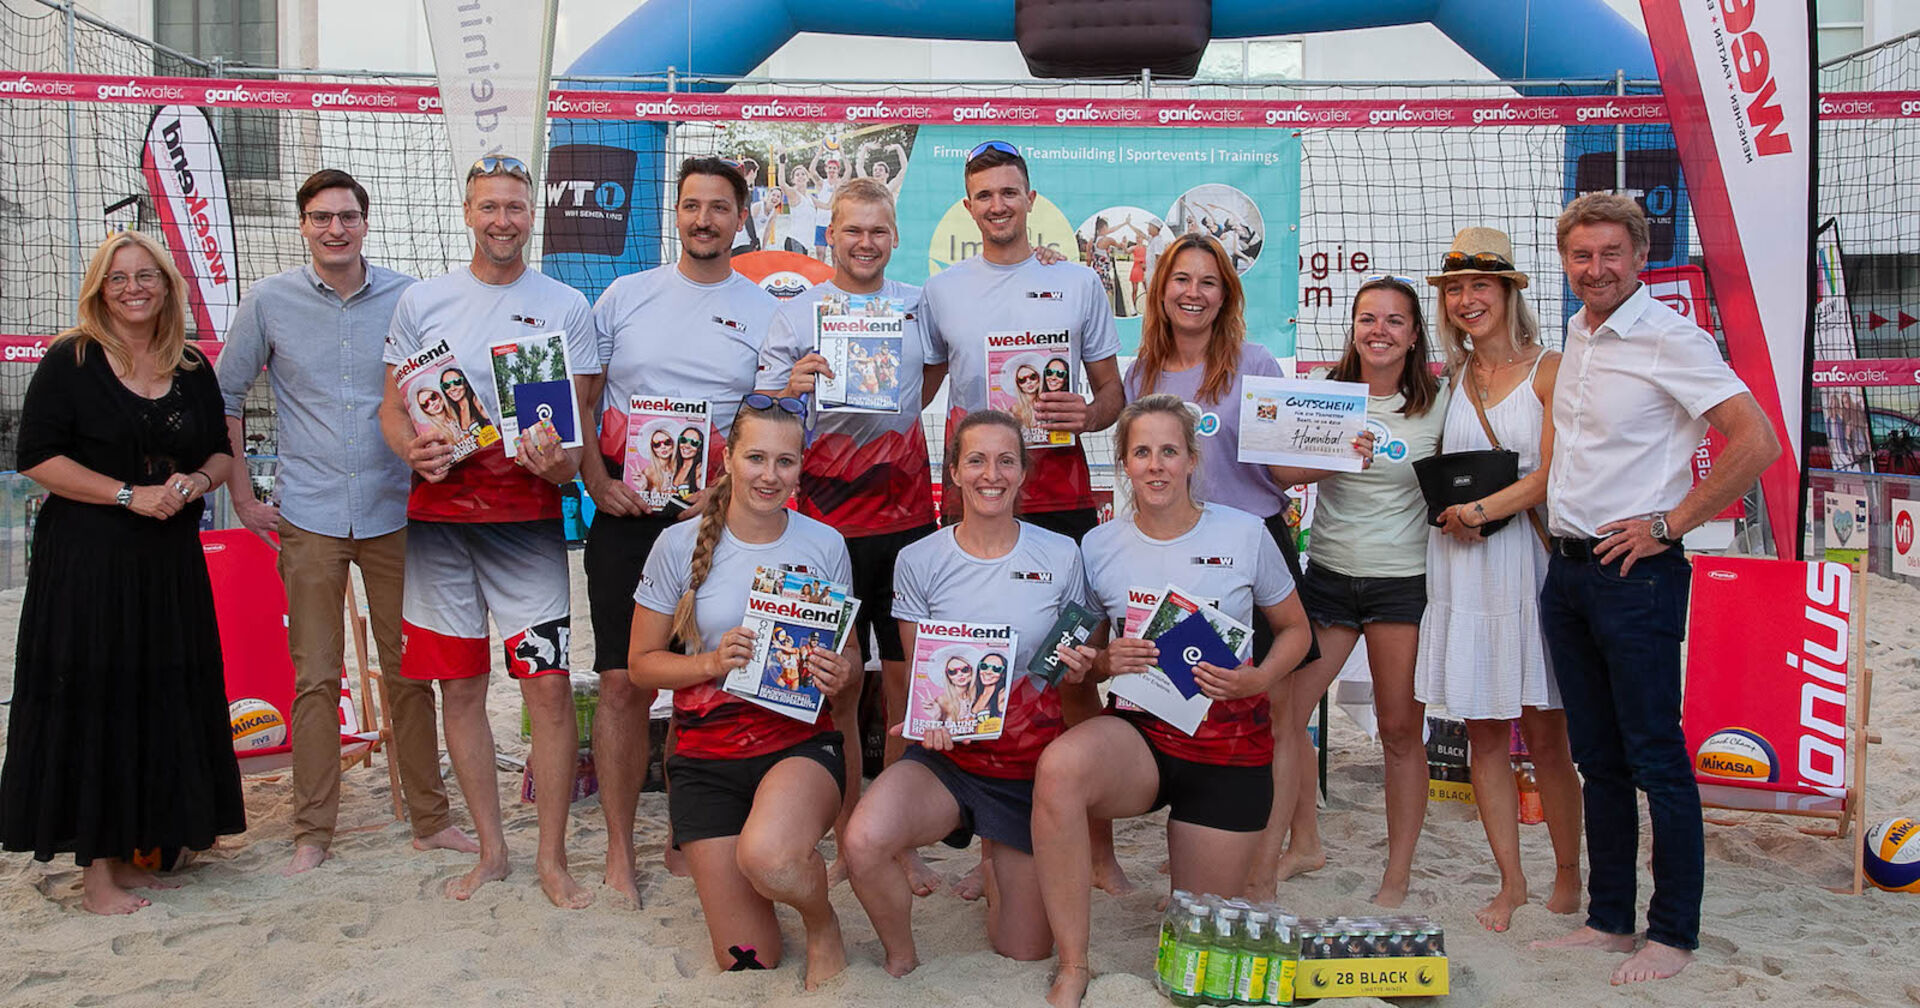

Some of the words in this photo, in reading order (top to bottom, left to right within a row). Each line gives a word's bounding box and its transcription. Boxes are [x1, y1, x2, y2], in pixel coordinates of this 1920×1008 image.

[1027, 147, 1116, 163] Teambuilding
[1126, 148, 1207, 163] Sportevents
[1218, 149, 1279, 165] Trainings
[1299, 246, 1369, 280] gie
[823, 319, 902, 333] weekend
[988, 330, 1069, 347] weekend
[631, 398, 707, 414] weekend
[1286, 397, 1354, 411] GUTSCHEIN
[1291, 425, 1344, 448] Hannibal
[1129, 590, 1160, 606] we
[750, 598, 840, 624] weekend
[919, 623, 1010, 639] weekend
[1437, 744, 1464, 758] BLACK
[1439, 789, 1471, 800] BLACK
[1336, 972, 1354, 984] 28
[1360, 971, 1407, 983] BLACK
